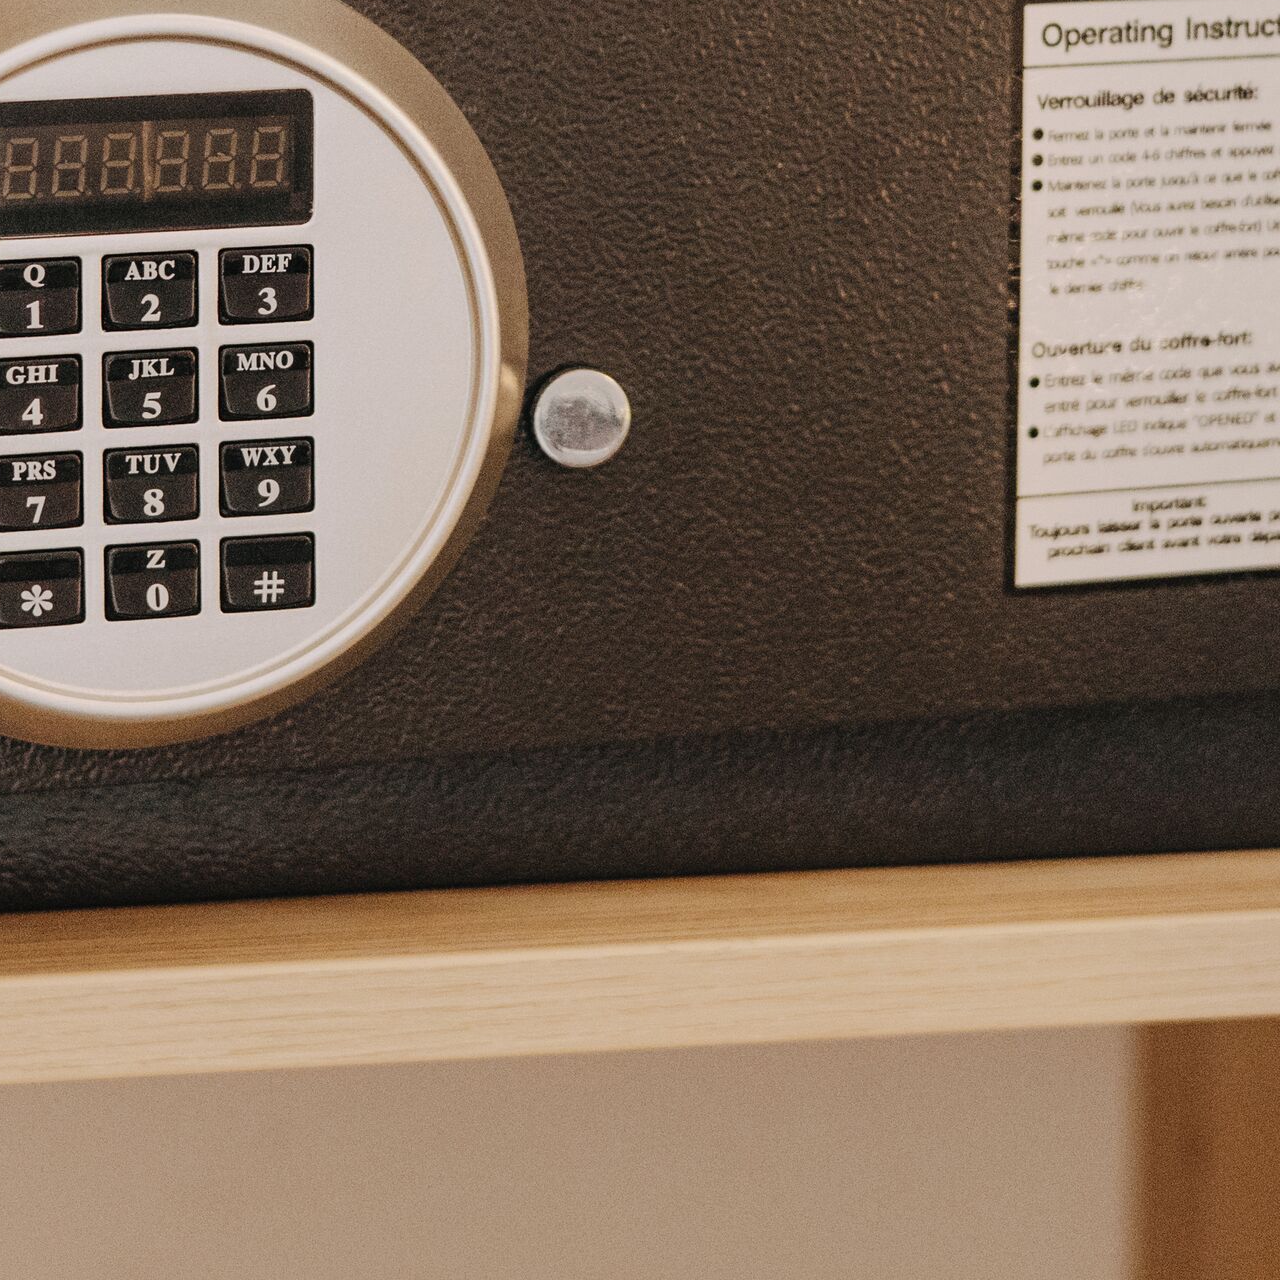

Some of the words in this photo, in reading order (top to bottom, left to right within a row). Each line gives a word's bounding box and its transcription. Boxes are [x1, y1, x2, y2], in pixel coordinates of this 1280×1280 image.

[1042, 17, 1173, 53] Operating
[1036, 88, 1144, 113] Verrouillage
[1152, 86, 1175, 104] de
[1184, 82, 1258, 102] sécurité:
[1109, 125, 1138, 142] porte
[1144, 124, 1154, 138] et
[1048, 153, 1083, 167] Entrez
[1089, 155, 1102, 165] un
[1142, 149, 1159, 162] 4-6
[23, 264, 45, 287] Q
[125, 261, 175, 281] ABC
[242, 254, 291, 274] DEF
[141, 294, 160, 322] 2
[258, 288, 278, 315] 3
[26, 301, 41, 329] 1
[1031, 336, 1121, 358] Ouverture
[1130, 334, 1151, 352] du
[1160, 328, 1252, 350] coffre-fort:
[128, 359, 174, 379] JKL
[237, 351, 293, 371] MNO
[6, 365, 58, 384] GHI
[142, 392, 162, 419] 5
[256, 385, 277, 411] 6
[22, 398, 43, 426] 4
[1113, 419, 1136, 433] LED
[126, 454, 181, 473] TUV
[240, 447, 297, 466] WXY
[12, 461, 56, 480] PRS
[143, 489, 164, 516] 8
[258, 480, 279, 506] 9
[27, 496, 45, 523] 7
[147, 550, 165, 569] Z
[147, 584, 169, 611] 0
